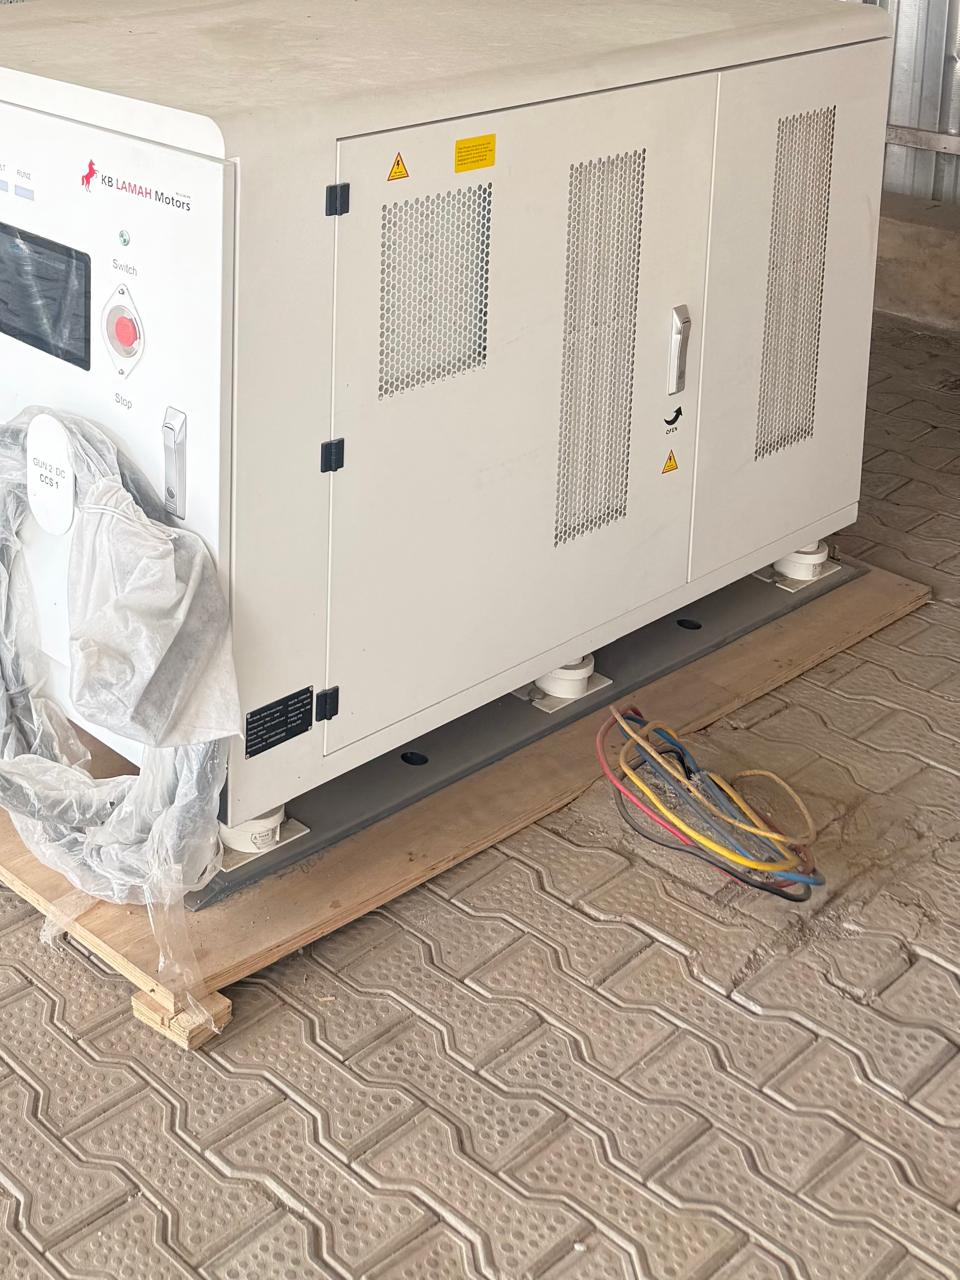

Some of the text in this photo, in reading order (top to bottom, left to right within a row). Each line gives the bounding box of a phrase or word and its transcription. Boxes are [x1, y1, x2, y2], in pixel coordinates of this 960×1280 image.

[101, 174, 191, 211] KB LAMAH Motors
[112, 258, 138, 276] Switch
[114, 392, 133, 410] Stop
[32, 457, 47, 470] GUN
[55, 467, 66, 479] DC
[40, 473, 54, 487] CCS
